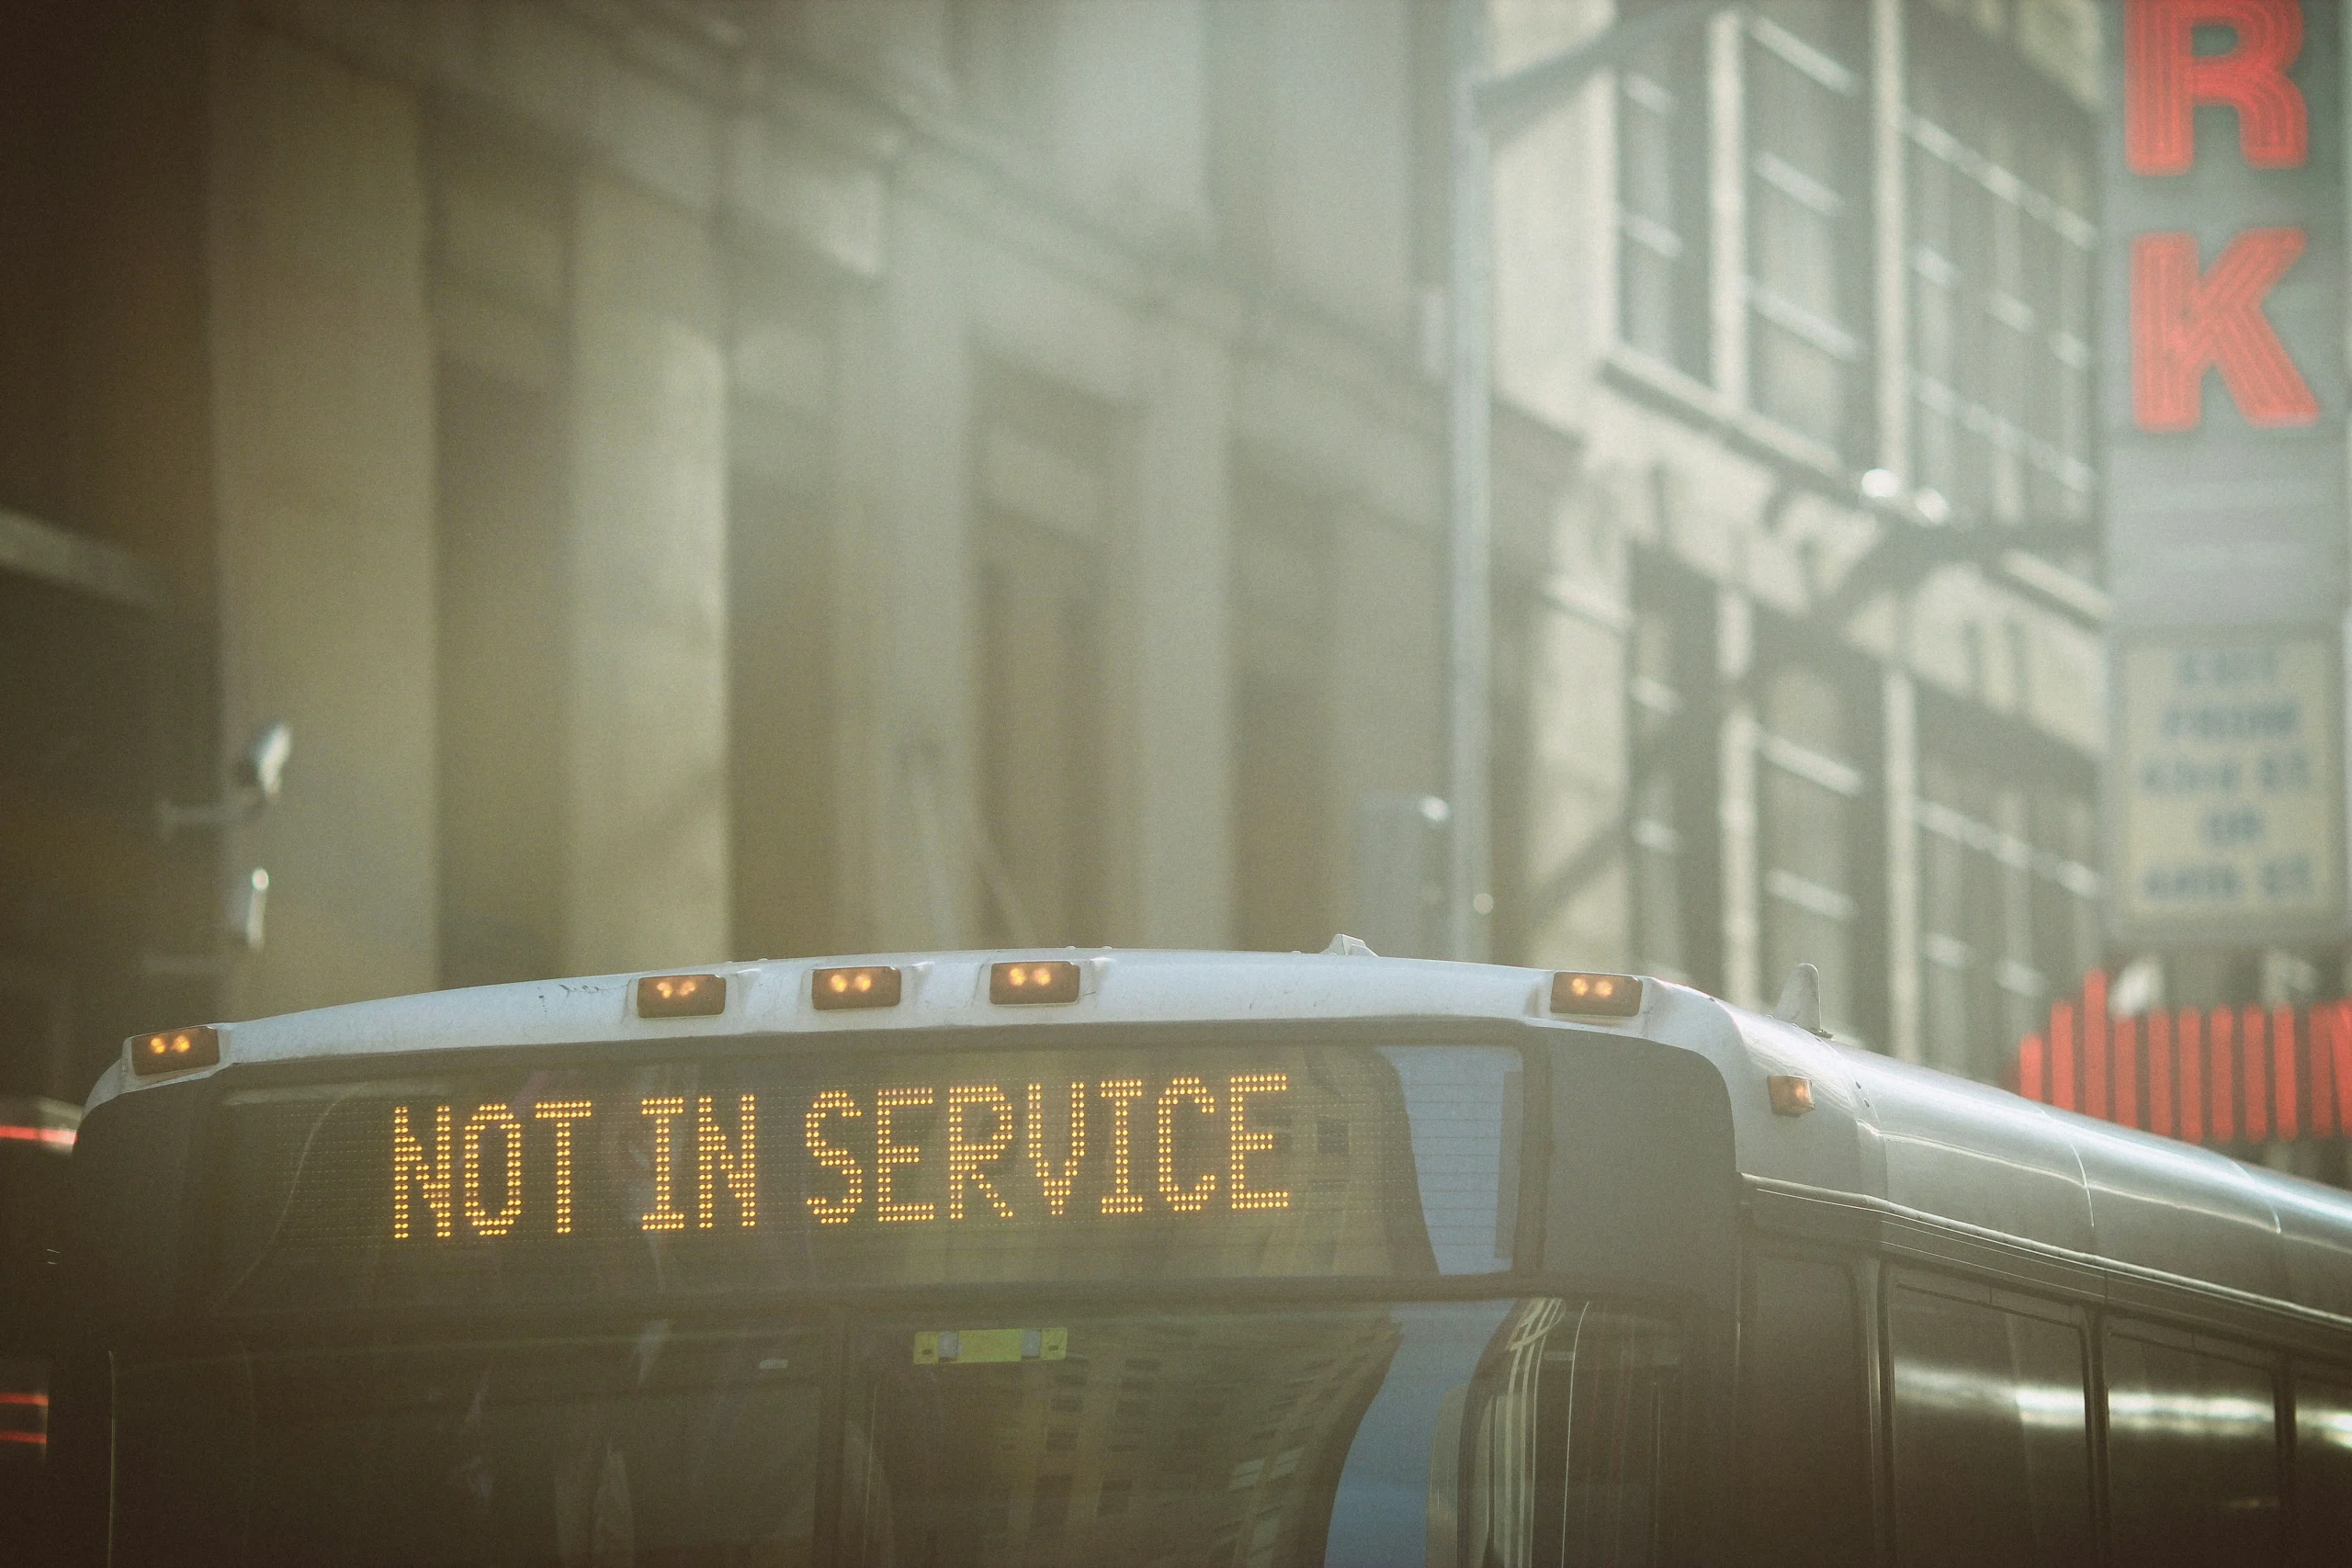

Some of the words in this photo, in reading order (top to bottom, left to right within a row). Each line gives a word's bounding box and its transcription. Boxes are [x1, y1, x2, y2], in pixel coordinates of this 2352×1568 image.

[394, 1100, 593, 1239] NOT
[641, 1094, 756, 1231] IN
[805, 1074, 1289, 1224] SERVICE
